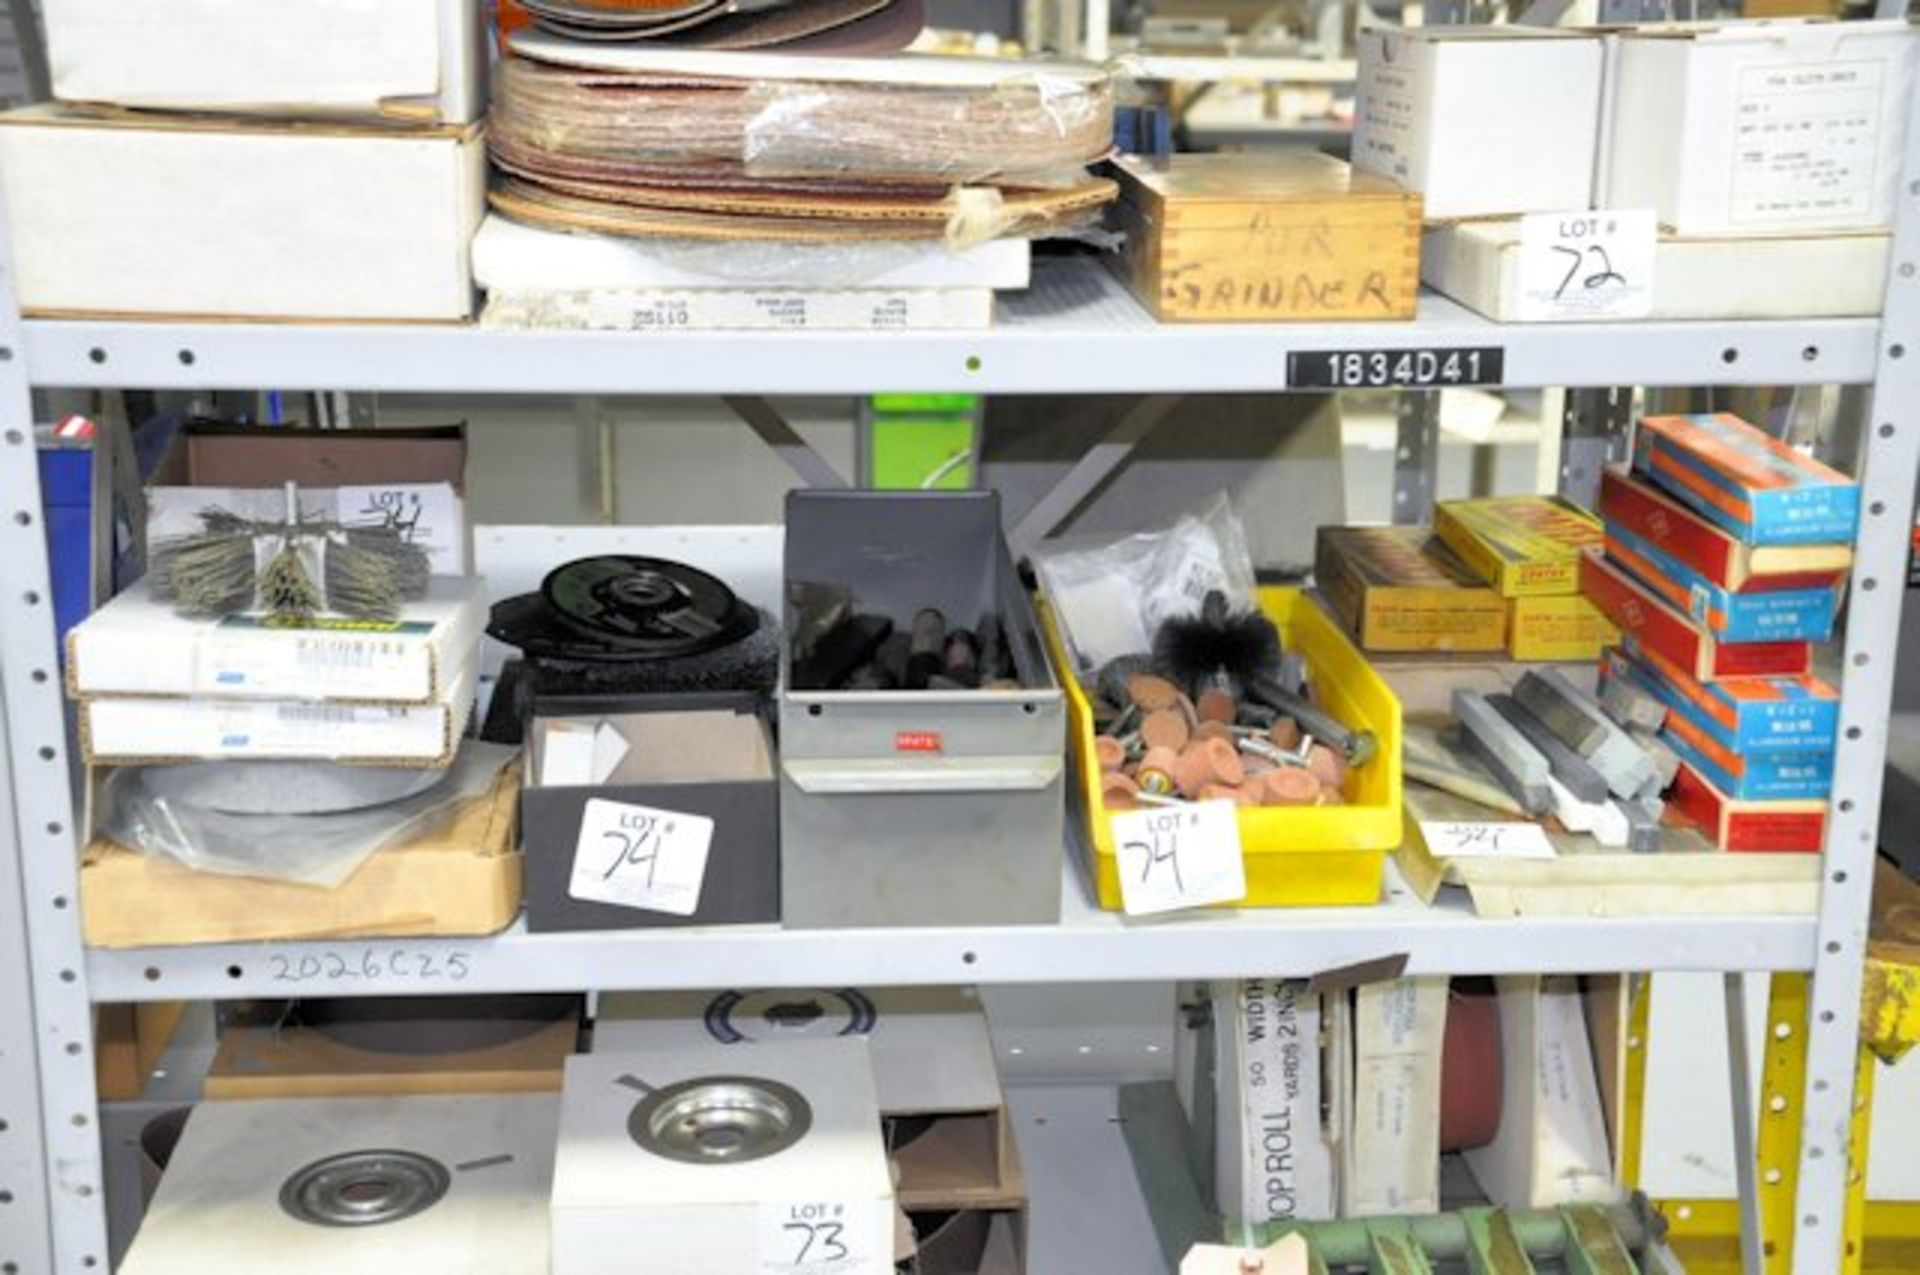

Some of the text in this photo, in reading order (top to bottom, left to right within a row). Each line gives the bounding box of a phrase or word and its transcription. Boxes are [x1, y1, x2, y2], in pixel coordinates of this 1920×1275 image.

[1558, 218, 1598, 238] LOT
[1549, 243, 1627, 301] 72
[1327, 350, 1482, 385] 1834D41
[368, 491, 404, 510] LOT
[619, 812, 659, 832] LOT
[1146, 811, 1183, 834] LOT
[602, 820, 661, 890] 74
[1122, 833, 1184, 895] 74
[1282, 1041, 1301, 1101] YARDS
[1262, 1105, 1294, 1172] ROLL
[790, 1203, 827, 1219] LOT
[782, 1220, 848, 1266] 73
